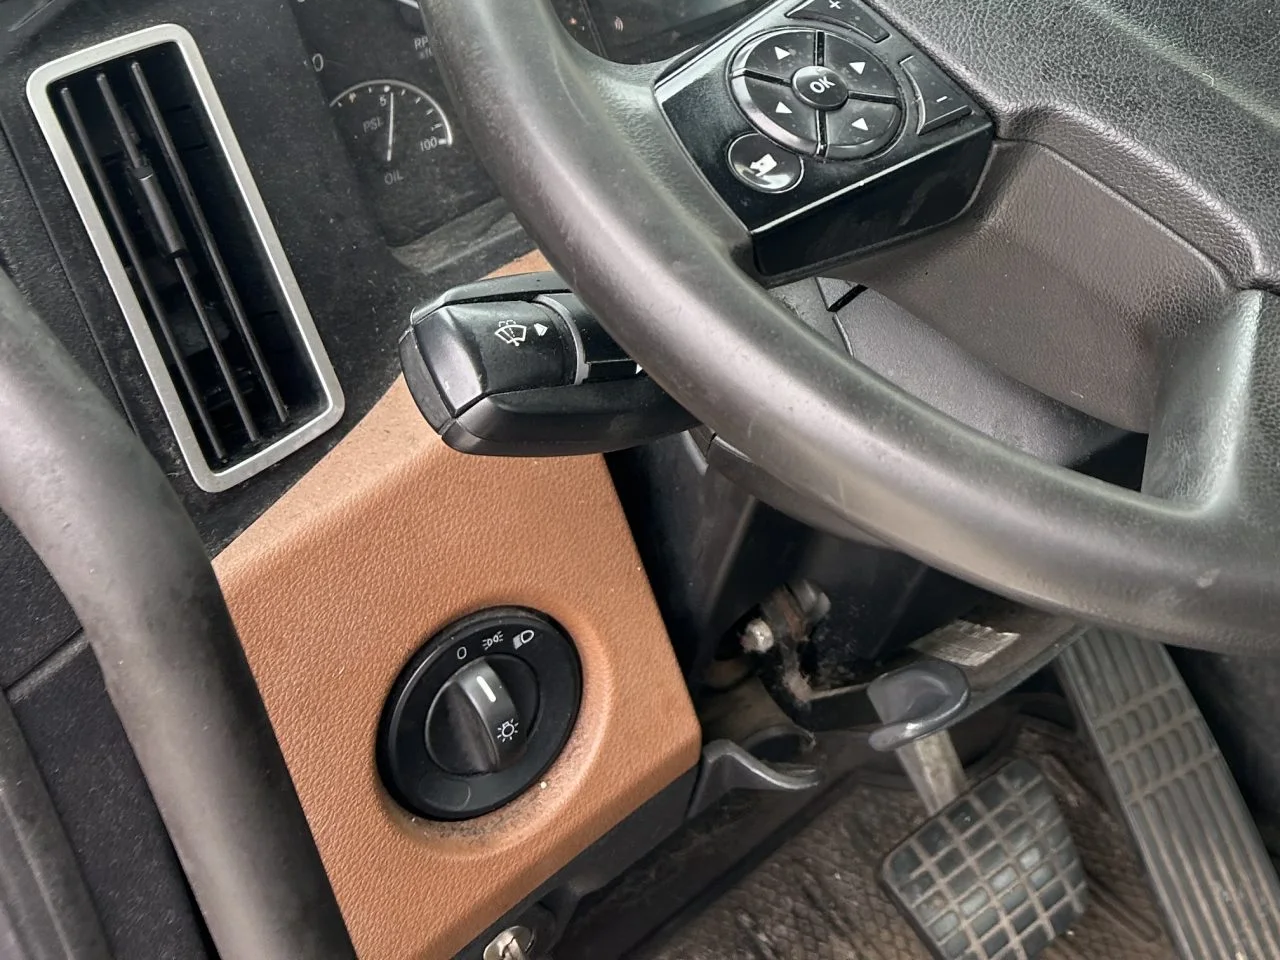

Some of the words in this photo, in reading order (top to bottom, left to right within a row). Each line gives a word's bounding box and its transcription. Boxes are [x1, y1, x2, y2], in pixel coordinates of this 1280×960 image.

[414, 36, 429, 51] RP
[312, 53, 324, 72] 0
[809, 75, 836, 95] OK
[420, 135, 437, 152] 100
[384, 169, 404, 186] OIL
